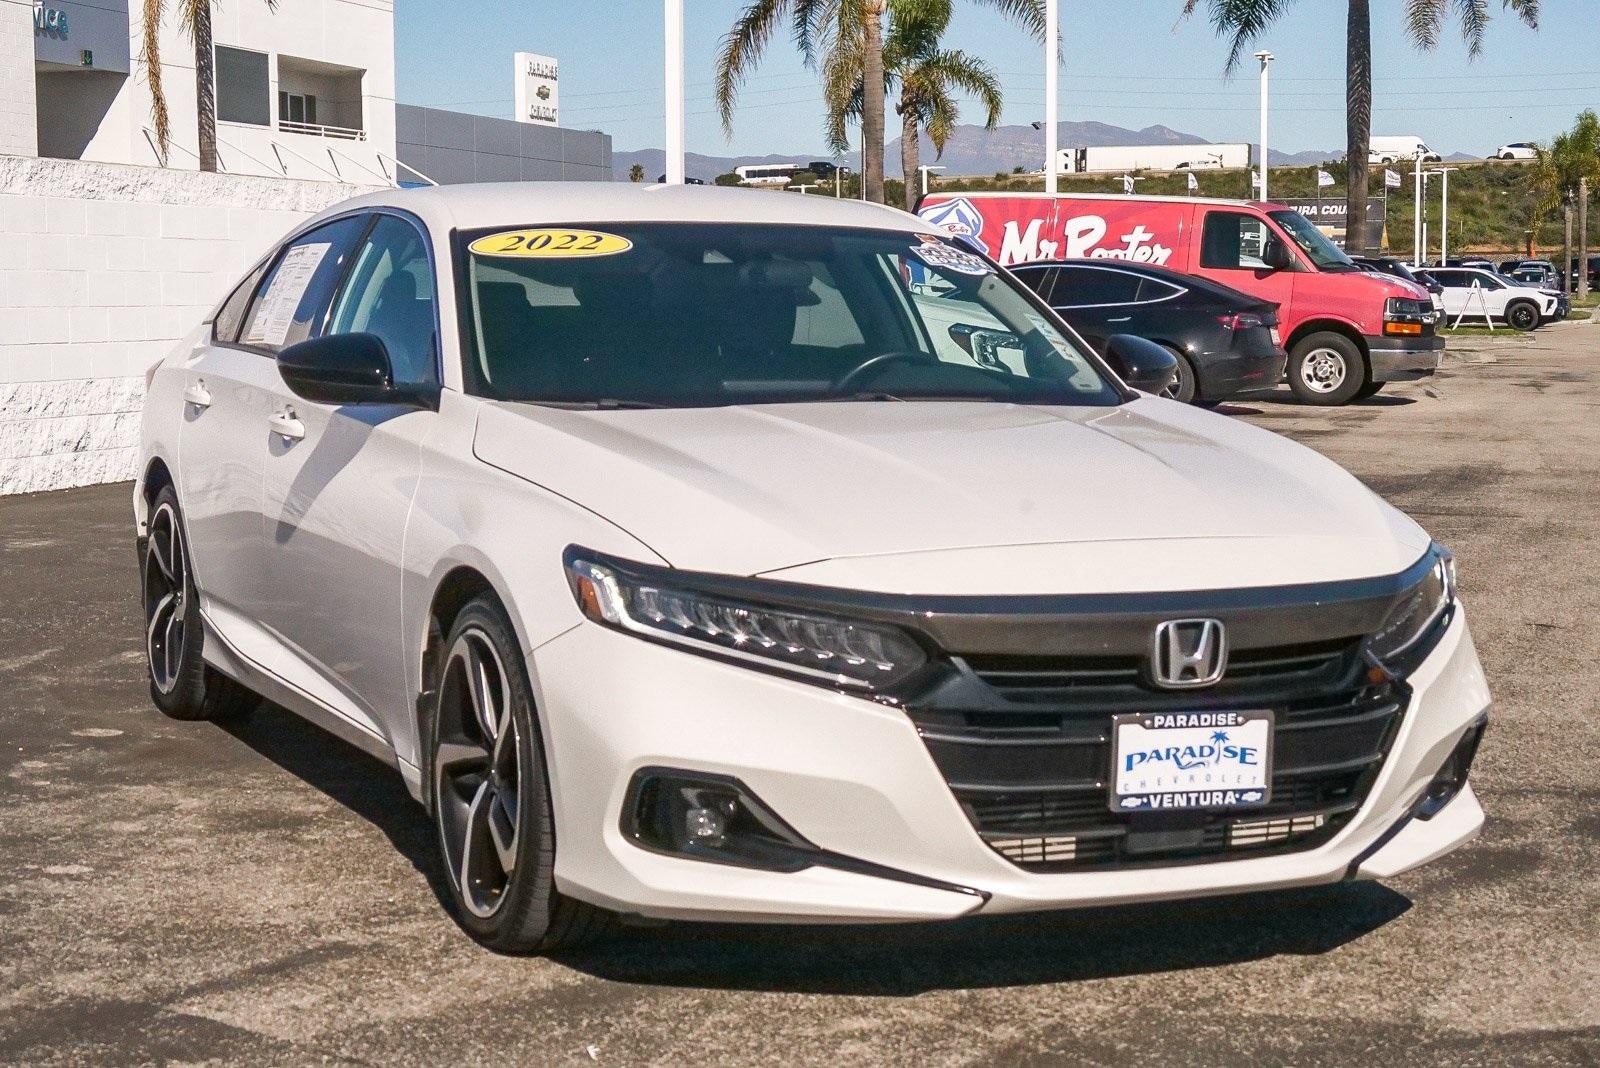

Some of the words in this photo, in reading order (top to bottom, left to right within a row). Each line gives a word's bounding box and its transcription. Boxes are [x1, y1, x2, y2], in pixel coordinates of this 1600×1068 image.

[497, 234, 603, 251] 2022
[999, 219, 1058, 265] Mr
[1065, 215, 1172, 266] Rooter
[1154, 713, 1238, 728] PARADISE
[1125, 738, 1258, 772] PARADISE
[1124, 774, 1257, 791] CHEVROLET
[1150, 792, 1237, 808] VENTURA
